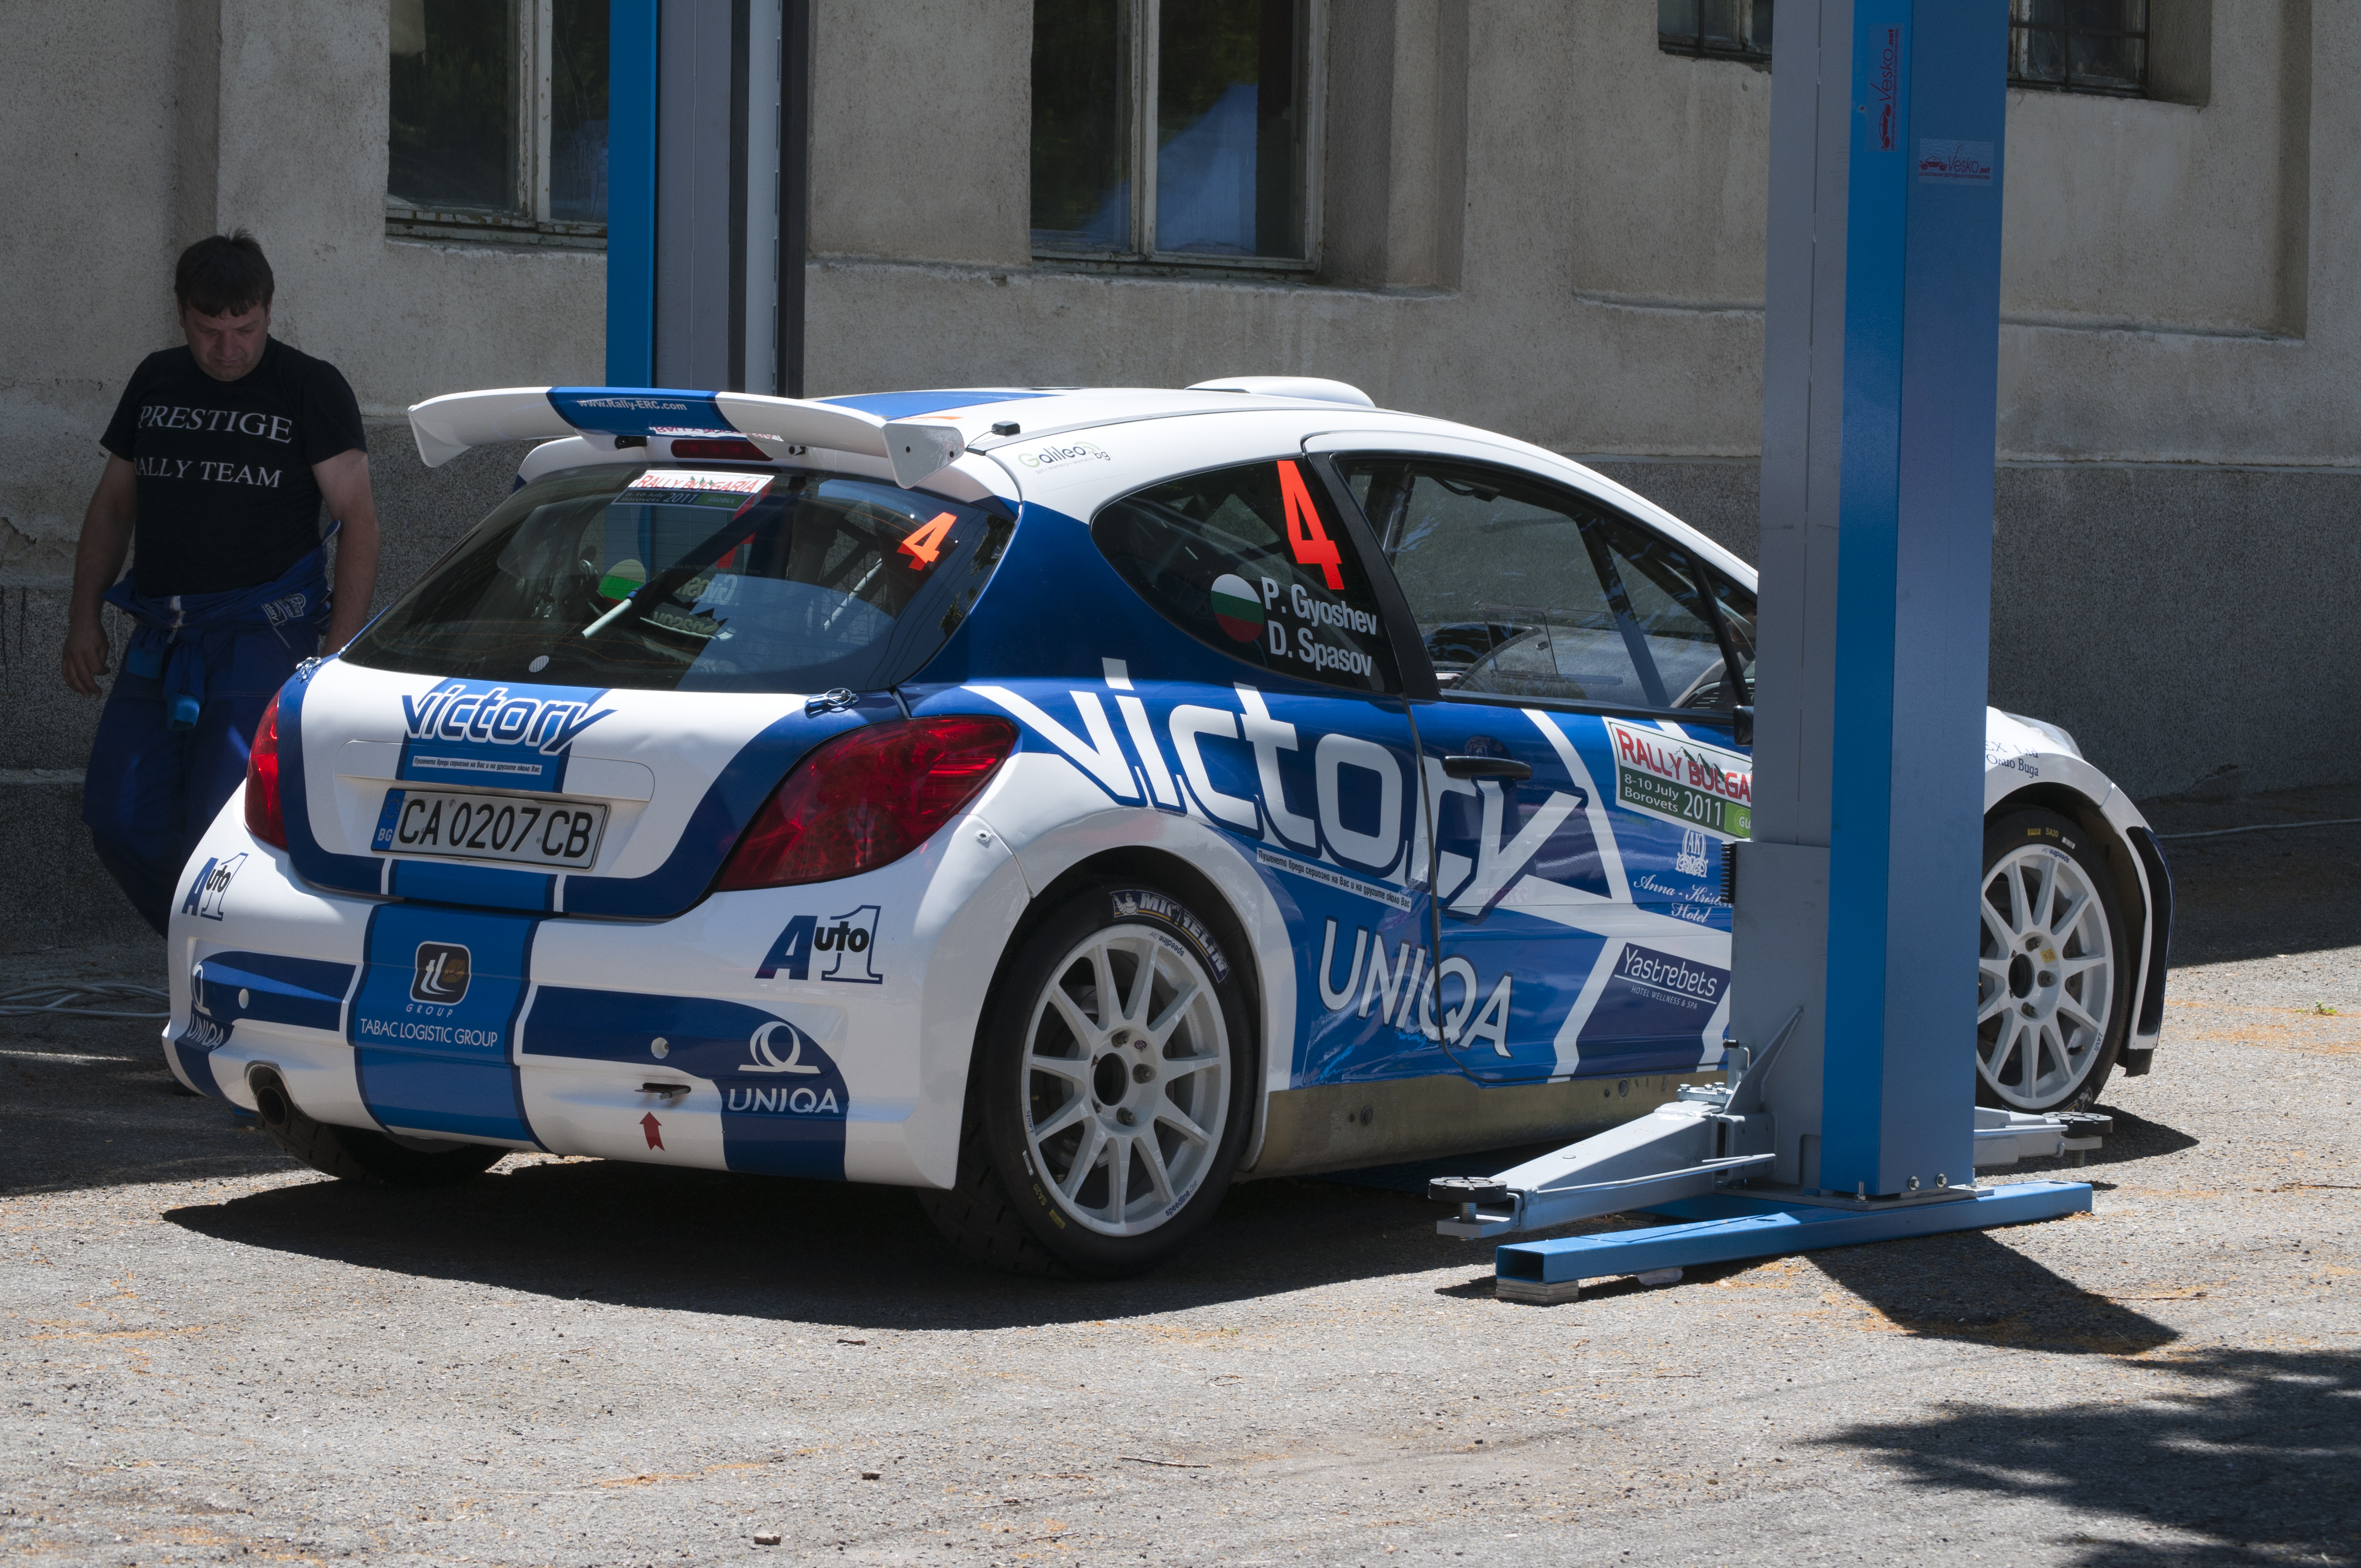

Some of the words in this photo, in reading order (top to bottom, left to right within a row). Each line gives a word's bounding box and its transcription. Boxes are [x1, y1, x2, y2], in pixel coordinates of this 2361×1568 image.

[578, 399, 687, 411] www.Rally-ERC.com
[138, 406, 292, 443] PRESTIGE
[200, 461, 282, 488] TEAM
[635, 475, 684, 489] RALLY
[683, 479, 759, 493] BULGARIA
[663, 492, 698, 503] 2011
[1277, 460, 1344, 590] 4
[897, 512, 958, 571] 4
[264, 602, 280, 621] ictory
[1261, 576, 1286, 614] P.
[1291, 584, 1377, 635] Gyoshev
[1268, 620, 1293, 658] D.
[1298, 628, 1372, 677] Spasov
[1615, 727, 1682, 780] RALLY
[1688, 760, 1753, 803] BULGA
[1624, 774, 1652, 791] 8-10
[1655, 783, 1679, 801] July
[1625, 787, 1678, 813] Borovets
[1683, 791, 1721, 826] 2011
[377, 828, 393, 842] BG
[399, 799, 442, 846] CA
[449, 802, 541, 852] 0207
[541, 810, 593, 858] CB
[2046, 827, 2059, 837] SA20
[1633, 874, 1675, 896] Anna
[1671, 903, 1711, 923] Hotel
[1159, 935, 1185, 957] speedline
[1624, 946, 1717, 997] Yastrebets
[1319, 917, 1513, 1060] UNIQA
[1631, 986, 1650, 997] HOTEL
[1652, 992, 1679, 1005] WELLNESS
[1687, 1001, 1697, 1010] SPA
[406, 1004, 453, 1017] GROUP
[187, 1014, 224, 1049] UNIQA
[361, 1019, 398, 1037] TABAC
[400, 1023, 453, 1043] LOGISTIC
[455, 1028, 498, 1047] GROUP
[728, 1087, 839, 1113] UNIQA
[1033, 1183, 1047, 1206] SA20
[1165, 1190, 1190, 1216] speedline
